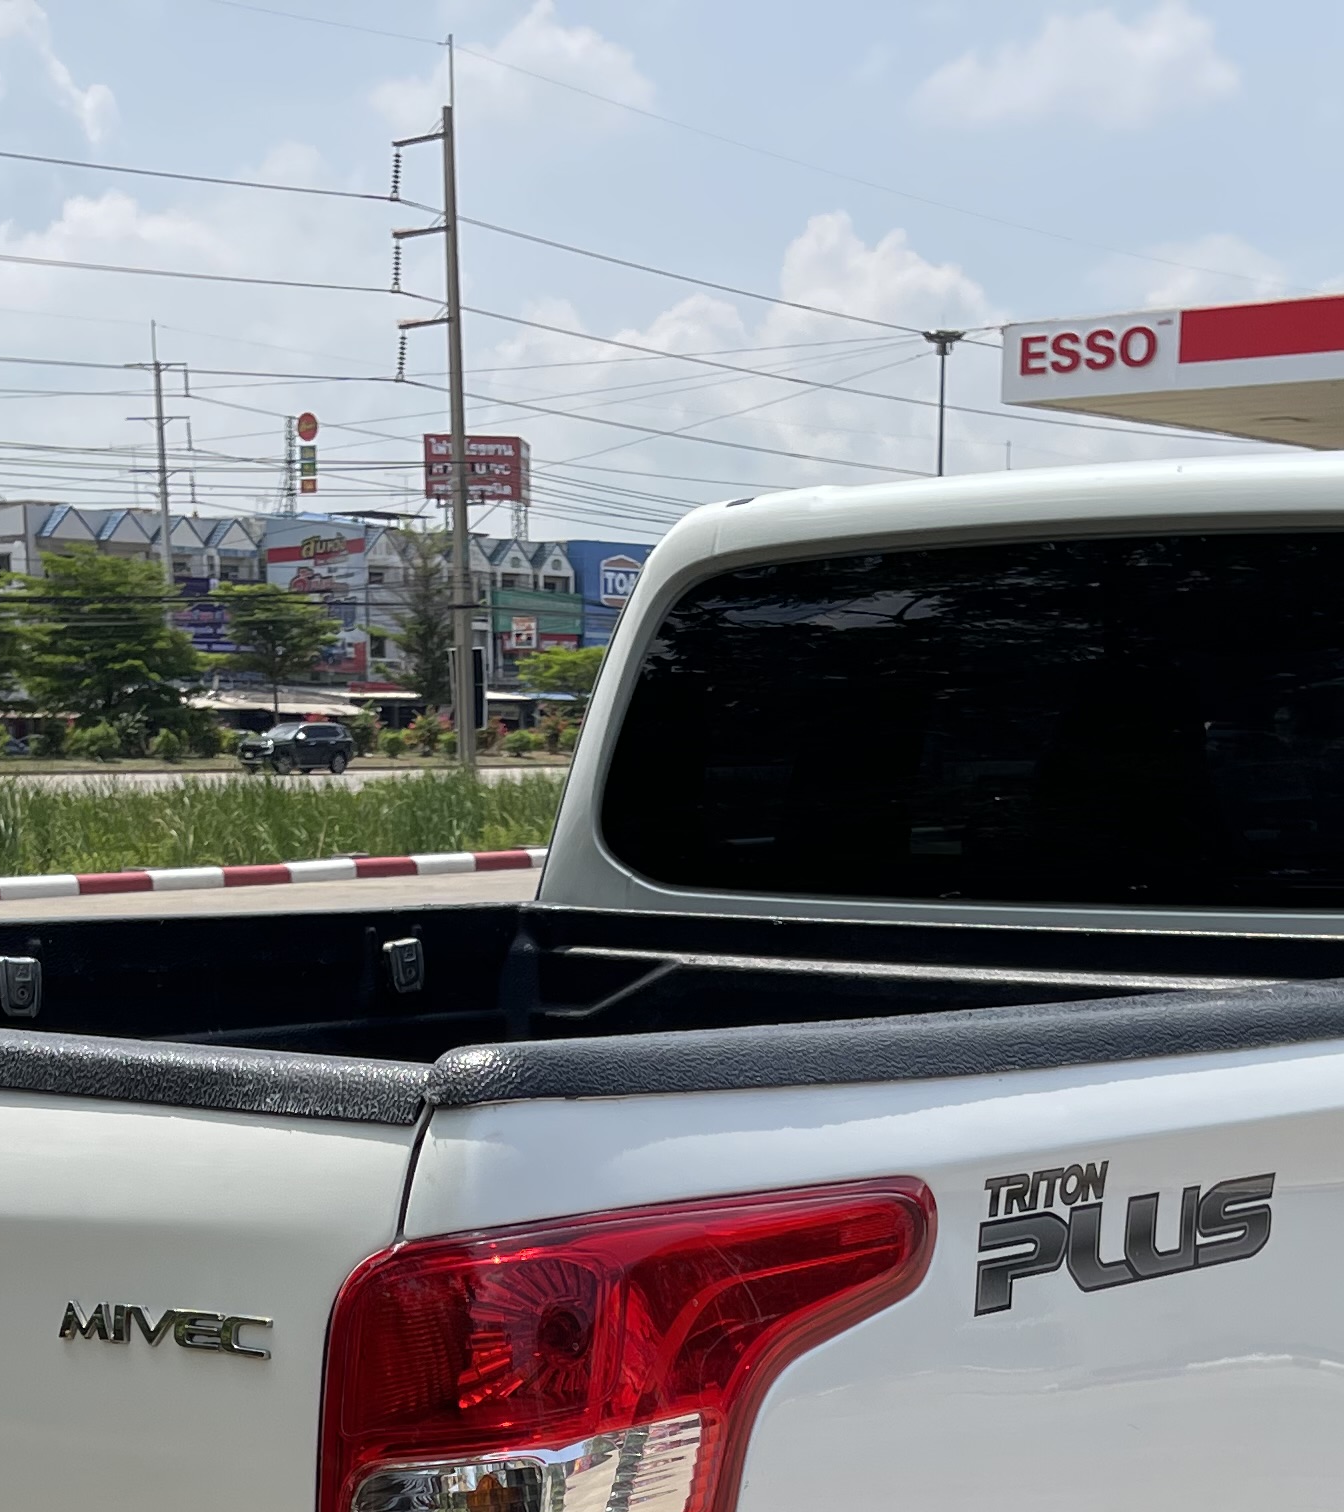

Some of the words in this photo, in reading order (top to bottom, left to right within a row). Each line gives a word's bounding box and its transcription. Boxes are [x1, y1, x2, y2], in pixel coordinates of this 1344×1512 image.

[1020, 326, 1157, 376] ESSO
[984, 1160, 1109, 1218] TRITON
[974, 1172, 1276, 1316] PLUS
[59, 1300, 273, 1360] MIVEC
